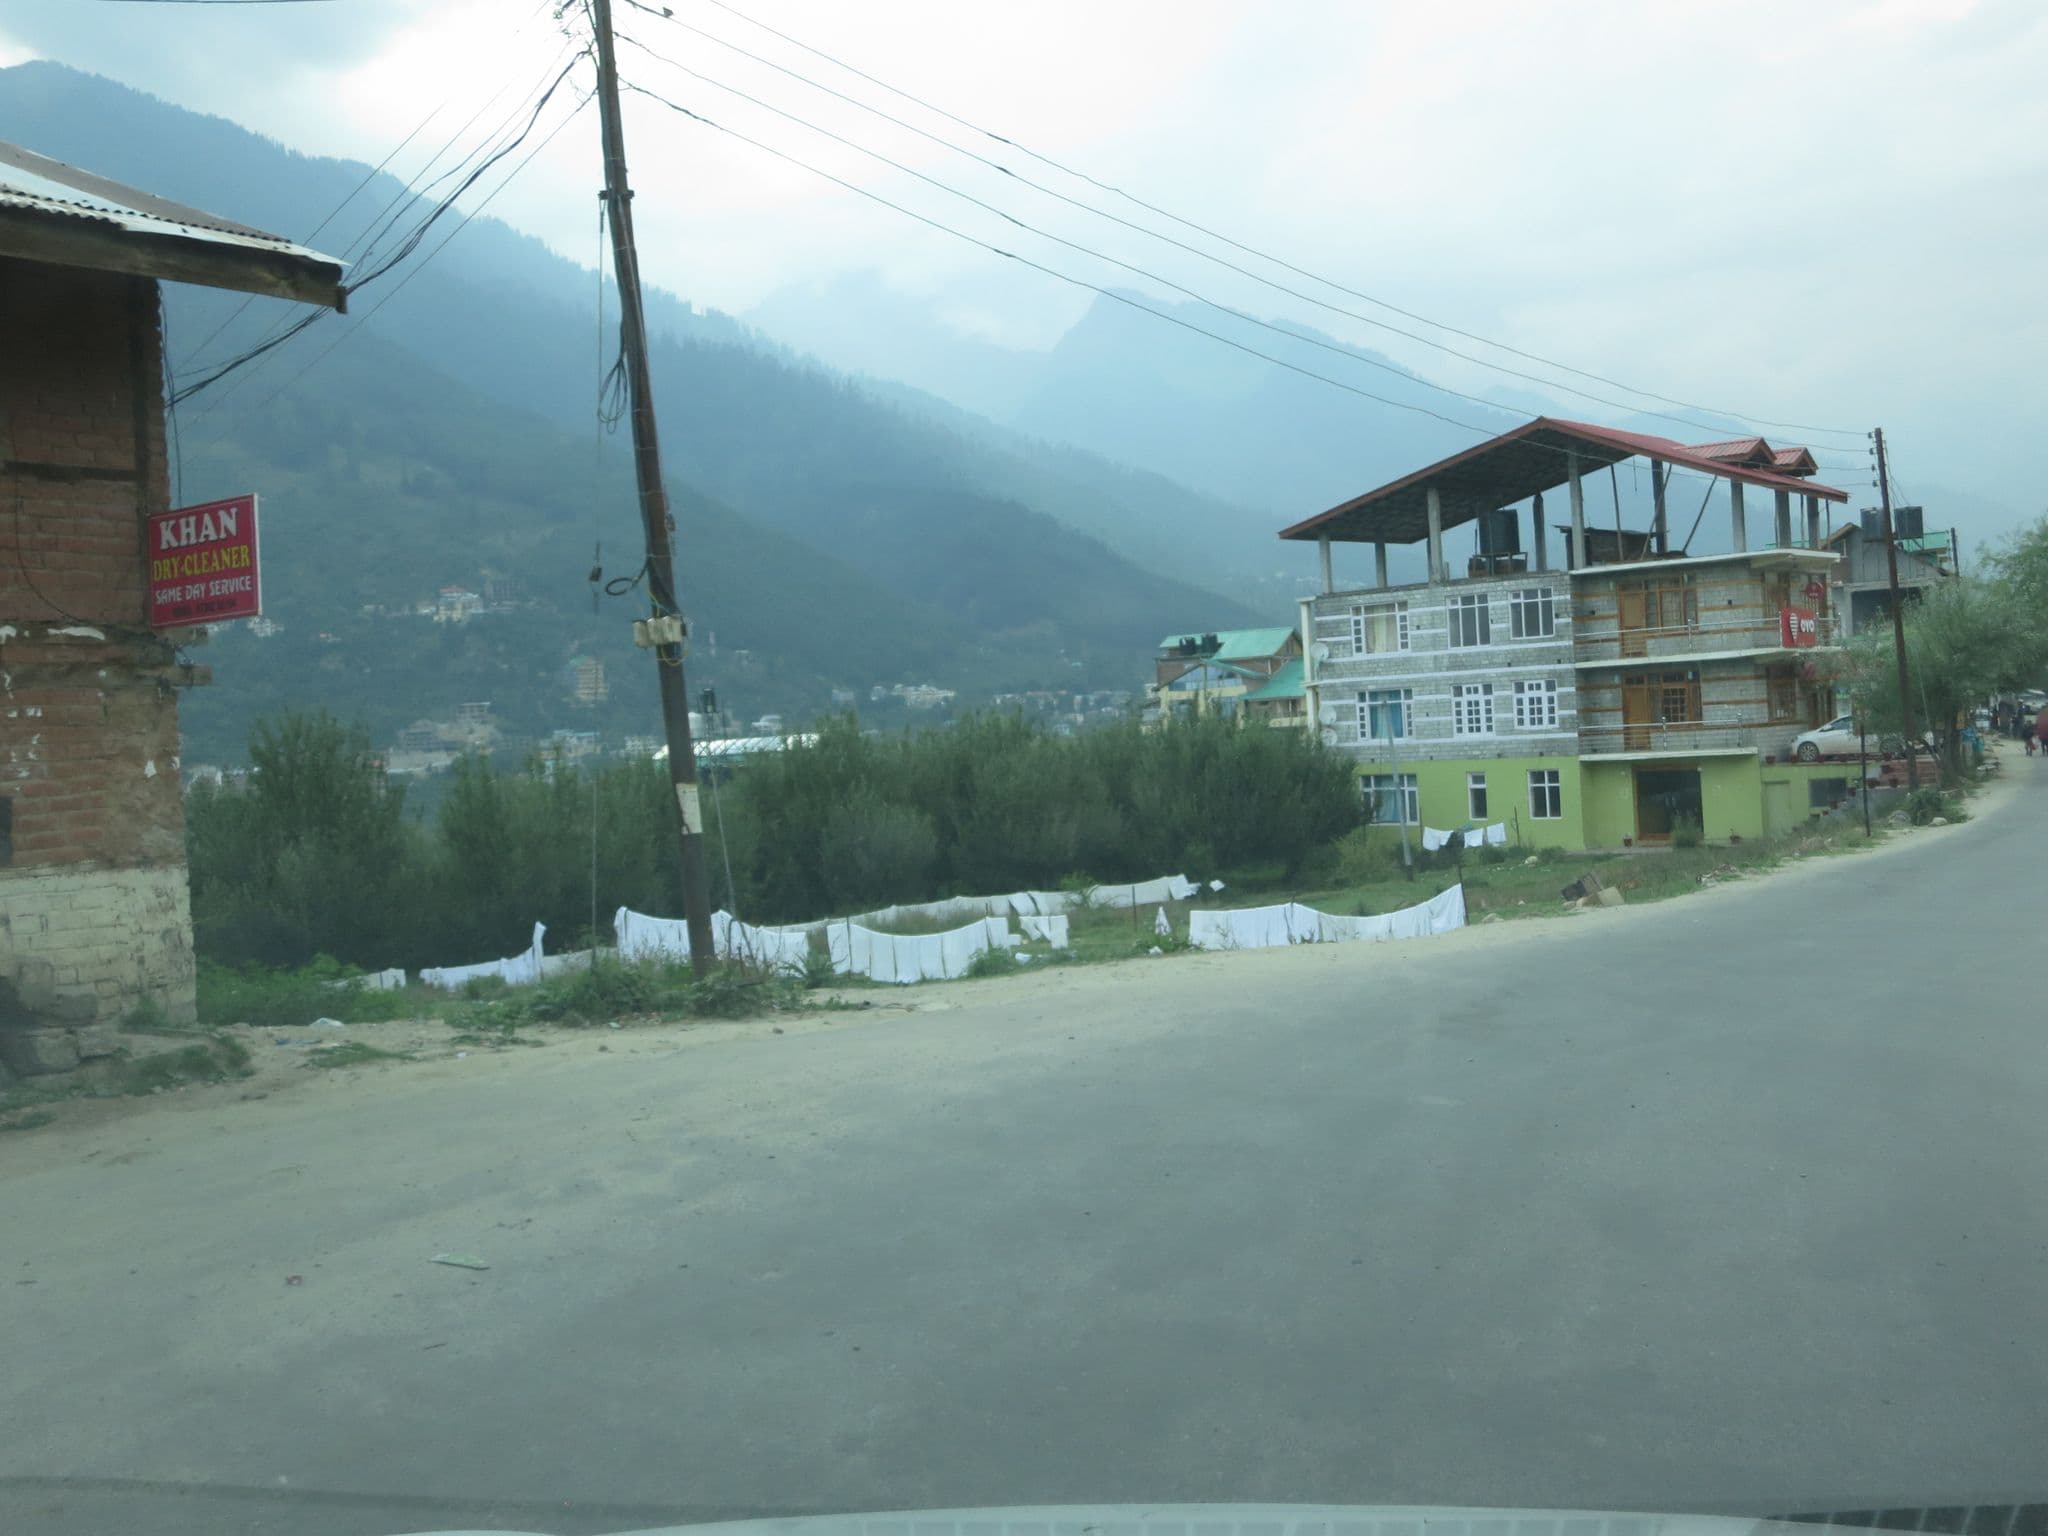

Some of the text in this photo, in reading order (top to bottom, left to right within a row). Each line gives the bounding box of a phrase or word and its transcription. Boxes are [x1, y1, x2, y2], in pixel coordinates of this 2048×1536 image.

[159, 507, 238, 550] KHAN
[155, 575, 252, 605] SAME DAY SERVICE
